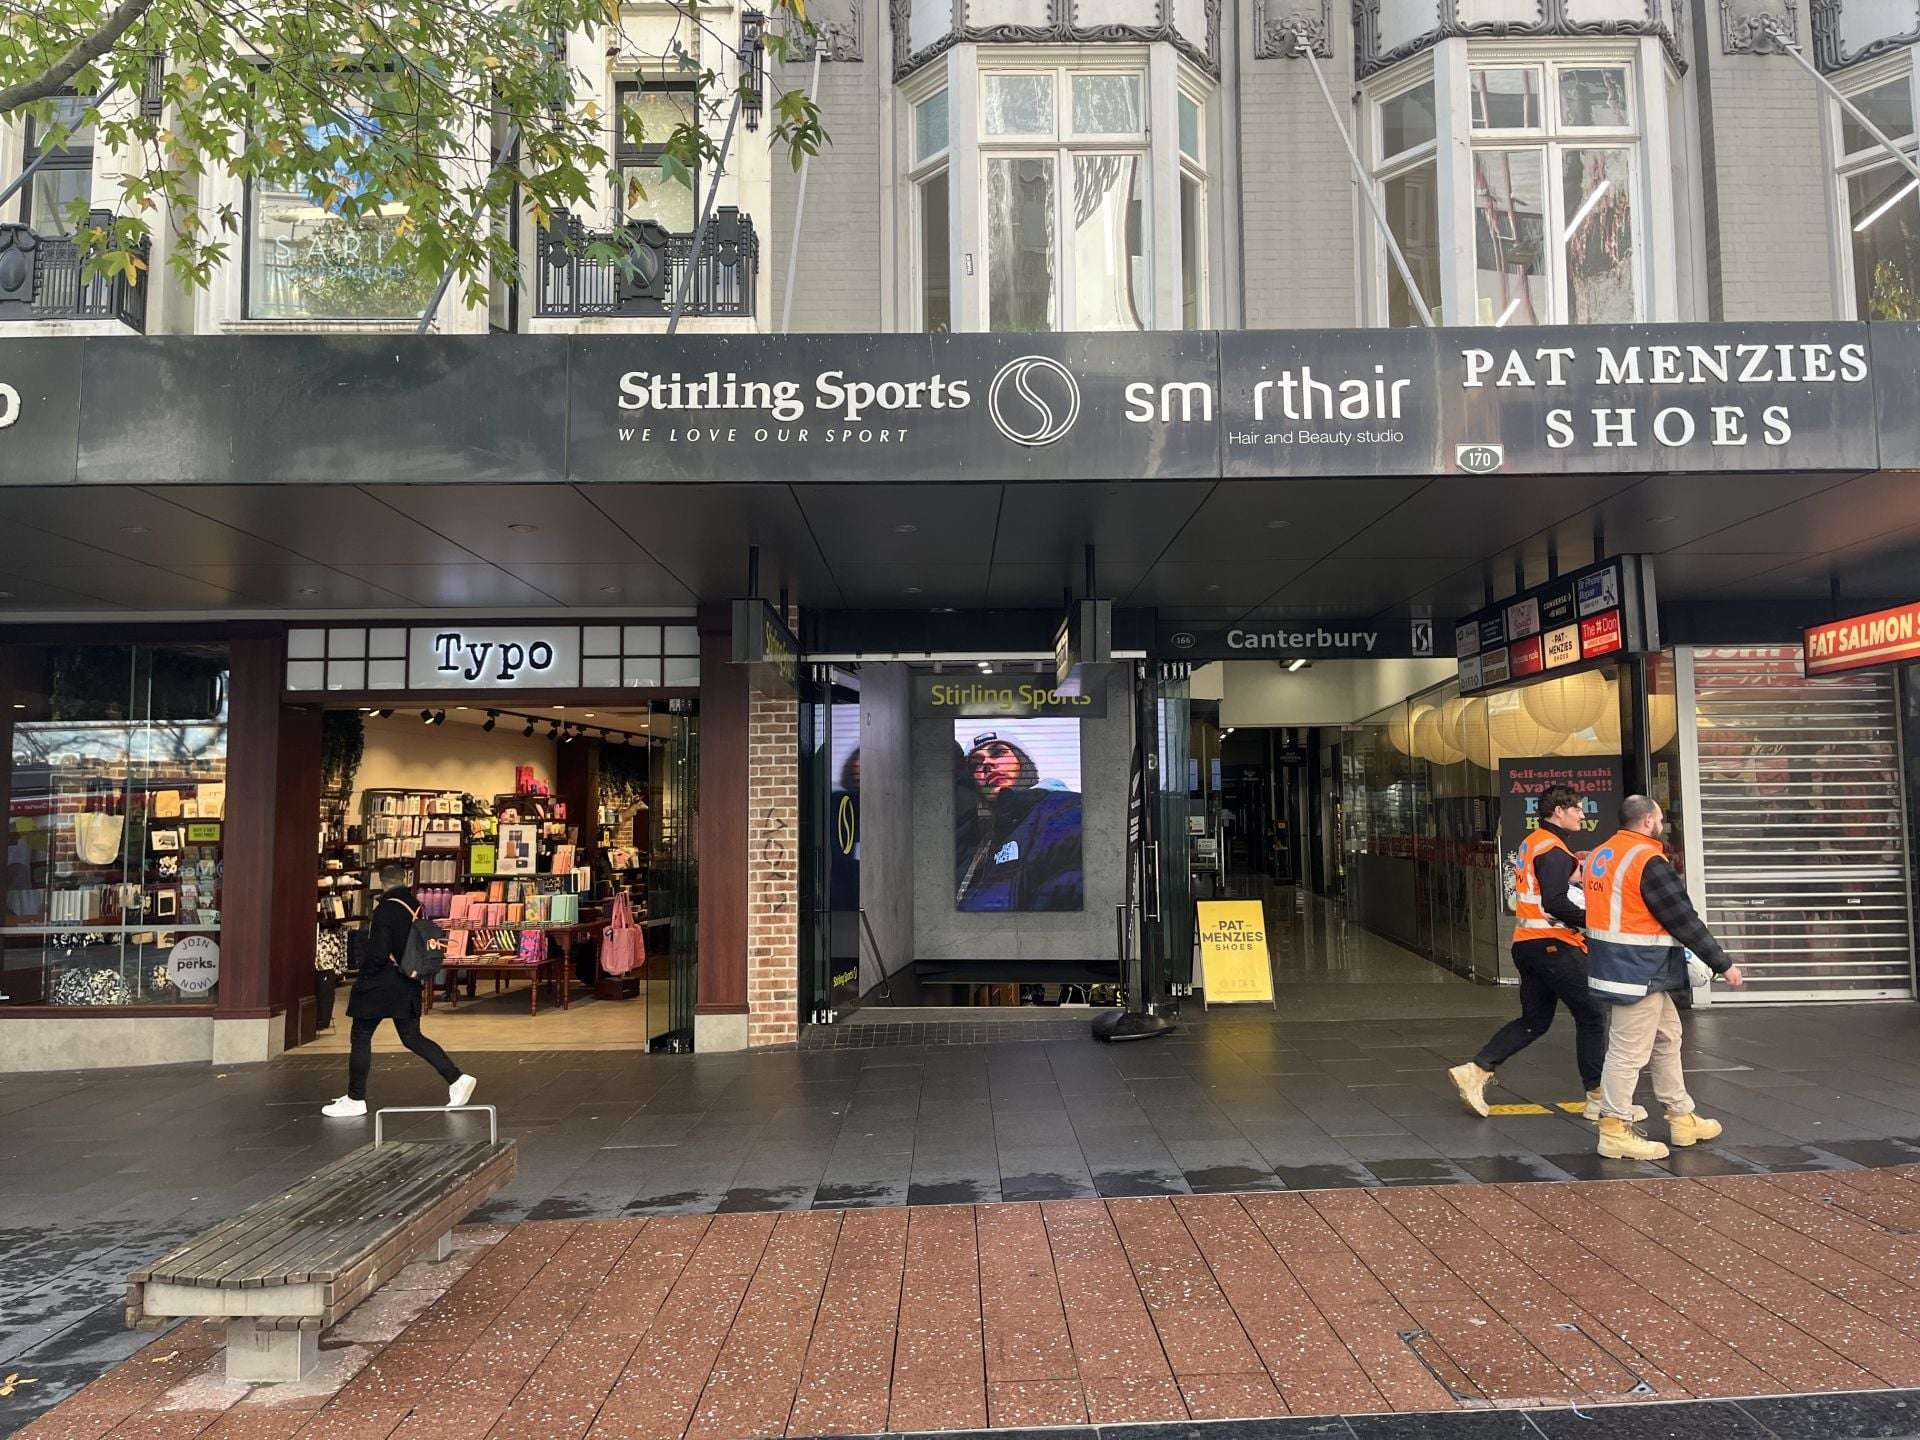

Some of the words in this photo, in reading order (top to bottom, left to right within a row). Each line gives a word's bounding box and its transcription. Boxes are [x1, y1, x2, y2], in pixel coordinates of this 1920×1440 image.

[1462, 347, 1575, 388] PAT
[1595, 343, 1868, 386] MENZIES
[618, 371, 804, 421] Stirling
[815, 371, 971, 421] Sports
[1125, 382, 1211, 422] sm
[1254, 365, 1411, 421] rthair
[1546, 405, 1792, 447] SHOES
[618, 428, 651, 443] WE
[670, 428, 737, 443] LOVE
[754, 428, 809, 443] OUR
[826, 428, 909, 443] SPORT
[1229, 430, 1259, 444] Hair
[1264, 430, 1292, 444] and
[1298, 430, 1352, 447] Beauty
[1356, 430, 1404, 444] studio
[1469, 452, 1491, 466] 170
[1227, 628, 1378, 651] Canterbury
[1554, 632, 1565, 644] PAT
[1809, 630, 1837, 658] FAT
[1838, 612, 1913, 652] SALMON
[435, 632, 554, 681] Typo
[931, 684, 1013, 710] Stirling
[1509, 768, 1573, 779] Self-select
[1576, 767, 1612, 778] sushi
[1218, 920, 1244, 931] PAT
[182, 937, 210, 951] JOIN
[1202, 931, 1264, 943] MENZIES
[1215, 943, 1254, 951] SHOES
[177, 956, 216, 972] perks.
